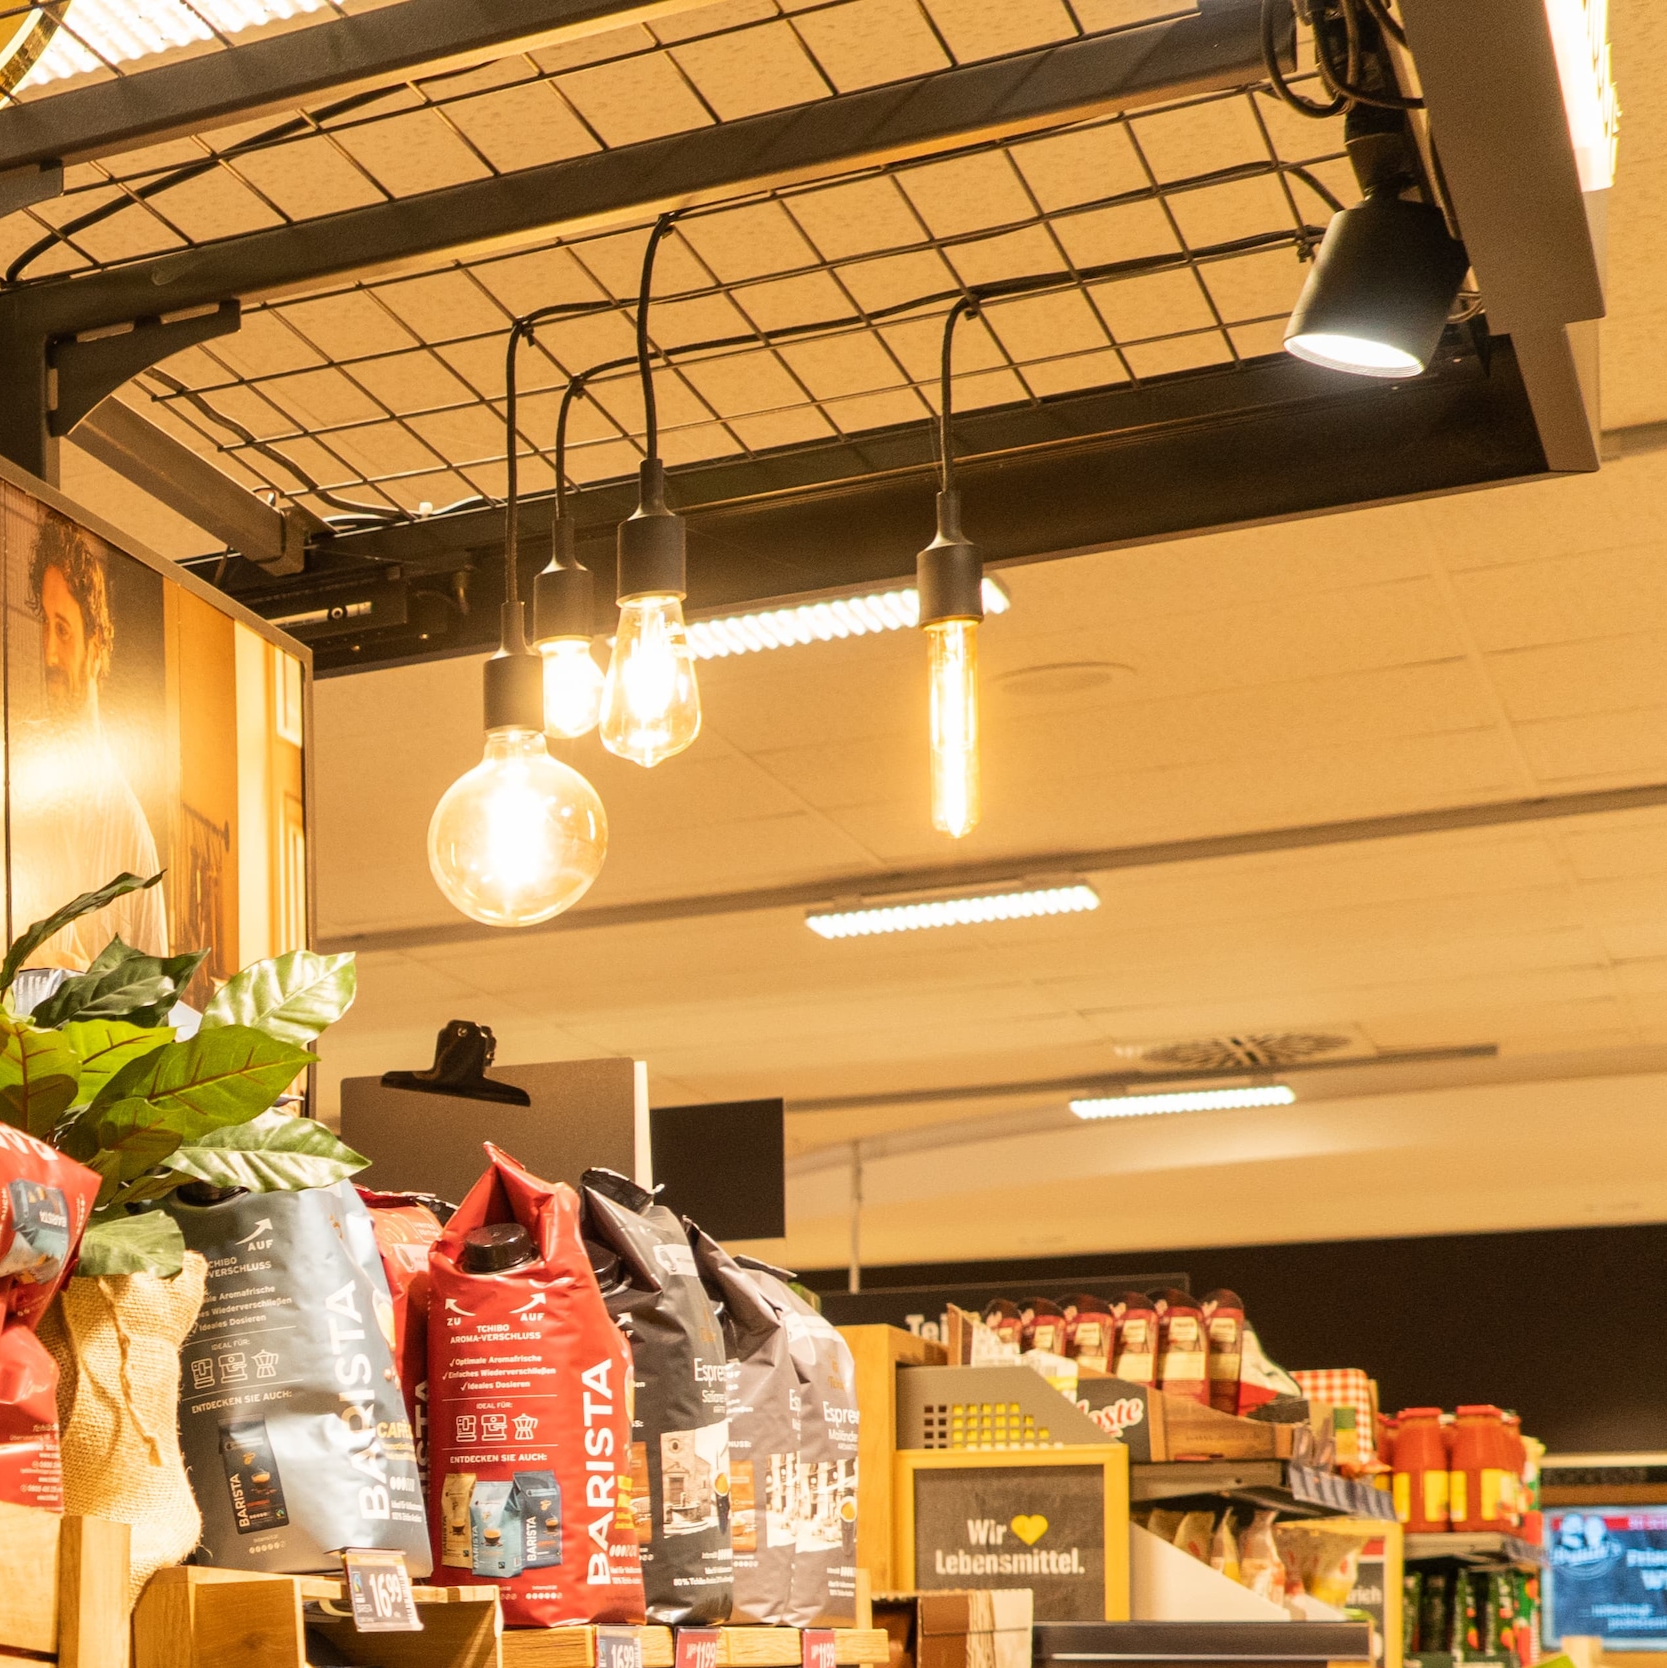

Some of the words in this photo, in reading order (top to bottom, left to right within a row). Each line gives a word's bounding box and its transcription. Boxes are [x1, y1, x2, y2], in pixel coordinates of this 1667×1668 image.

[248, 1240, 272, 1252] AUF
[219, 1285, 275, 1300] Aromafrische
[199, 1319, 229, 1332] Ideales
[232, 1314, 266, 1326] Dosieren
[451, 1332, 541, 1343] AROMA-VERSCHLUSS
[192, 1397, 242, 1413] ENTDECKEN
[263, 1390, 292, 1401] AUCH:
[326, 1280, 390, 1520] BARISTA
[582, 1359, 616, 1584] BARISTA
[968, 1518, 1006, 1547] Wir
[935, 1548, 1085, 1578] Lebensmittel.
